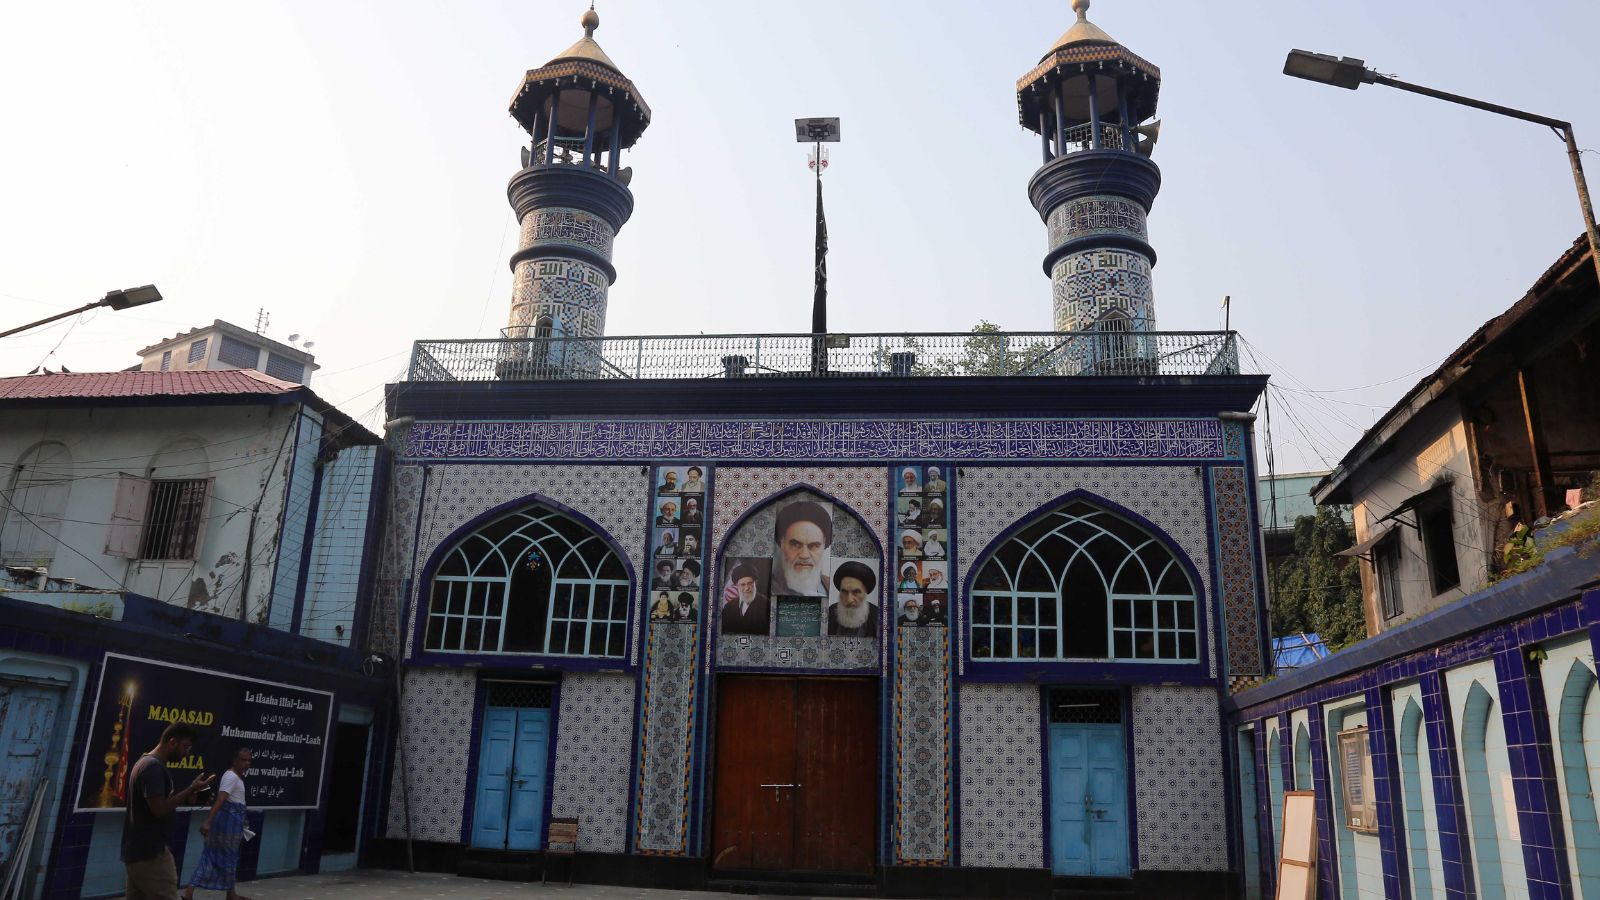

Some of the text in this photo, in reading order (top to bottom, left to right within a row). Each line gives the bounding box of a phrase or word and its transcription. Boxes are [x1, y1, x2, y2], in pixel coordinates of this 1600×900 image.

[245, 690, 254, 702] La
[147, 704, 214, 726] MAQASAD
[221, 725, 321, 745] Muhammadur Rasulul-Laah
